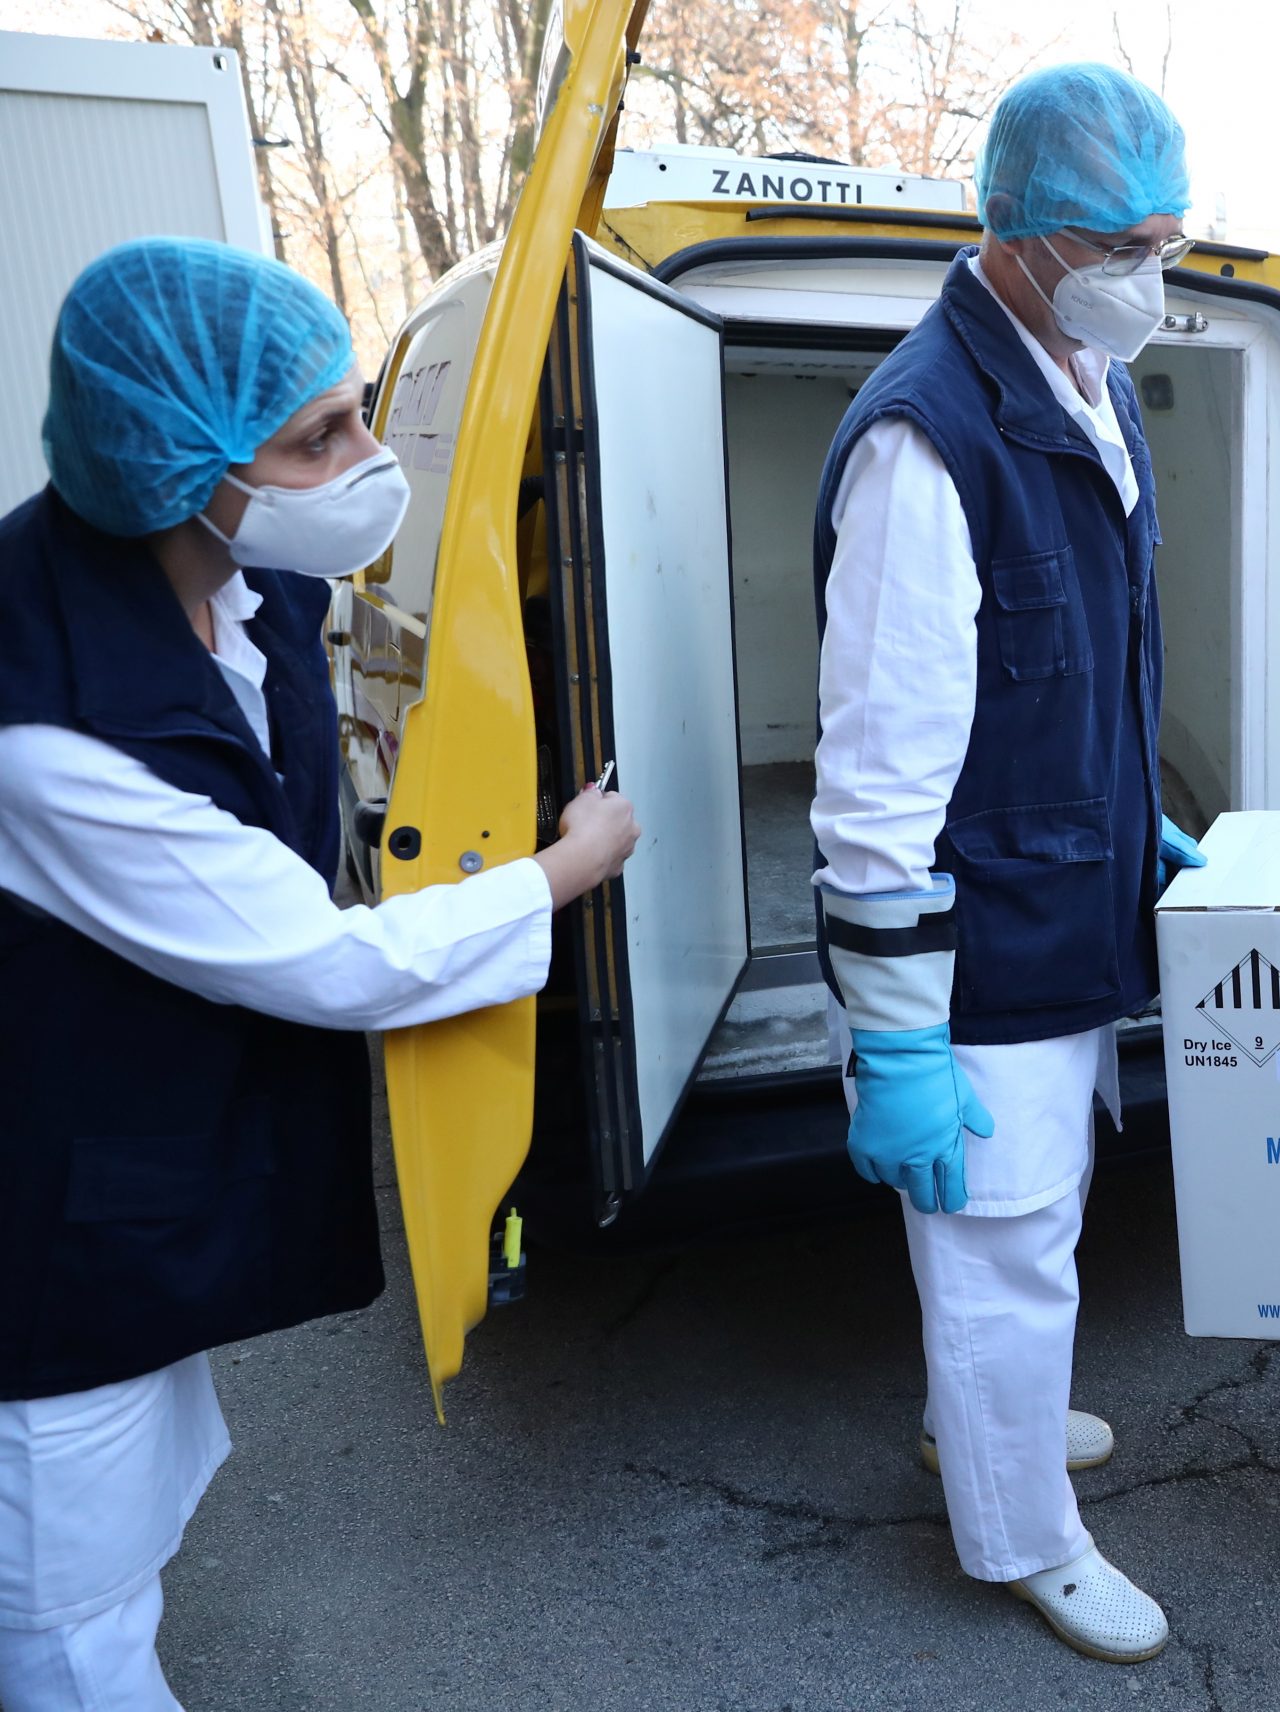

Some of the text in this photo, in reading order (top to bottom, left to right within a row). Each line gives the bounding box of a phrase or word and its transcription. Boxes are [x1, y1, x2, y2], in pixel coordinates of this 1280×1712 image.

[712, 169, 862, 204] ZANOTTI
[1184, 1038, 1232, 1053] Dry Ice
[1255, 1036, 1264, 1049] 9
[1185, 1055, 1238, 1067] UN1845
